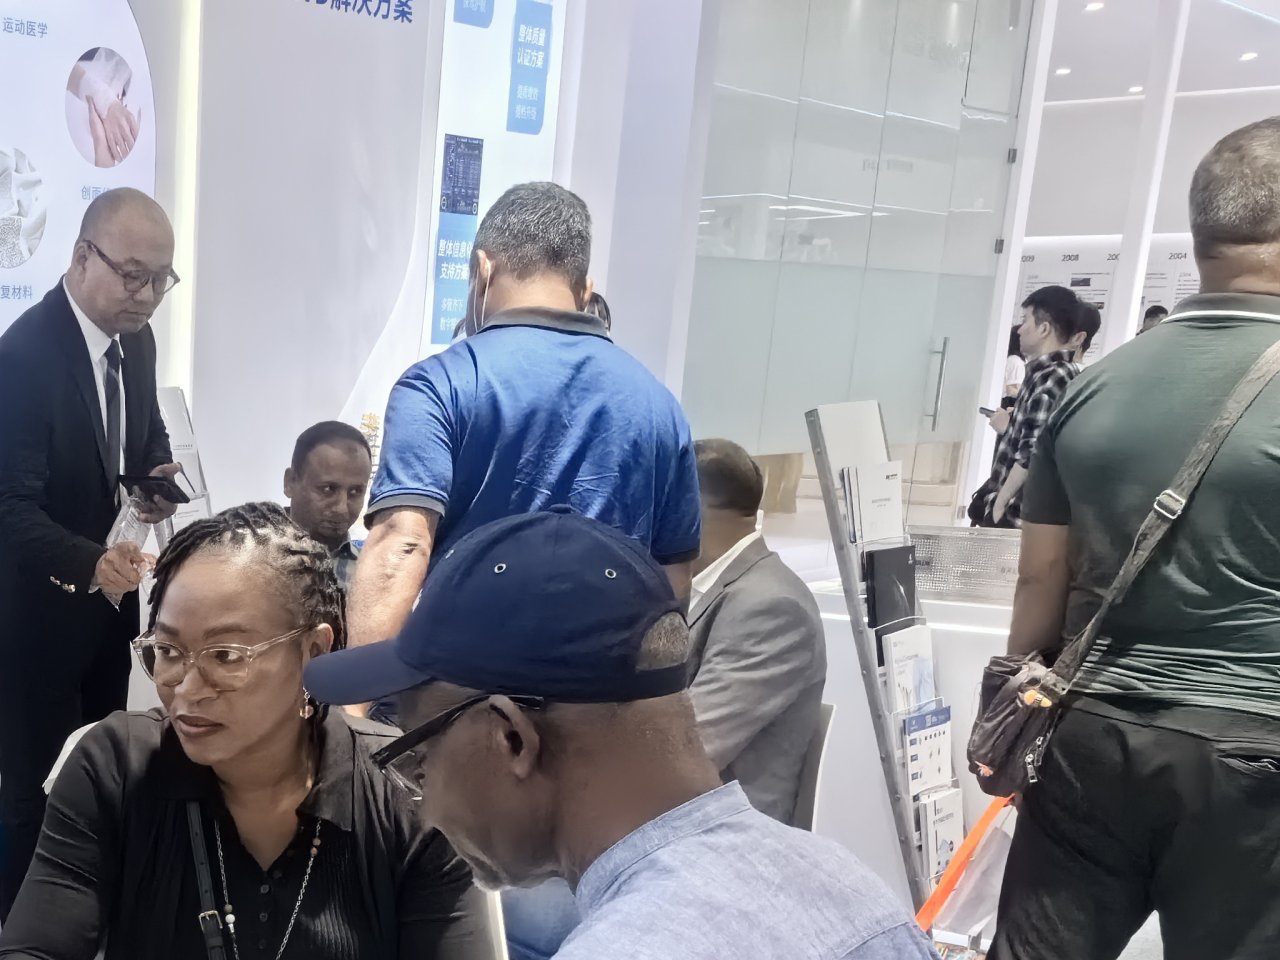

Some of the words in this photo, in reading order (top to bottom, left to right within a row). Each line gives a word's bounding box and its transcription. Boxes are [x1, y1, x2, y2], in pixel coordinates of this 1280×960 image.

[2, 16, 48, 38] 运动医学
[518, 24, 546, 46] 整体质量
[1168, 252, 1187, 261] 2004
